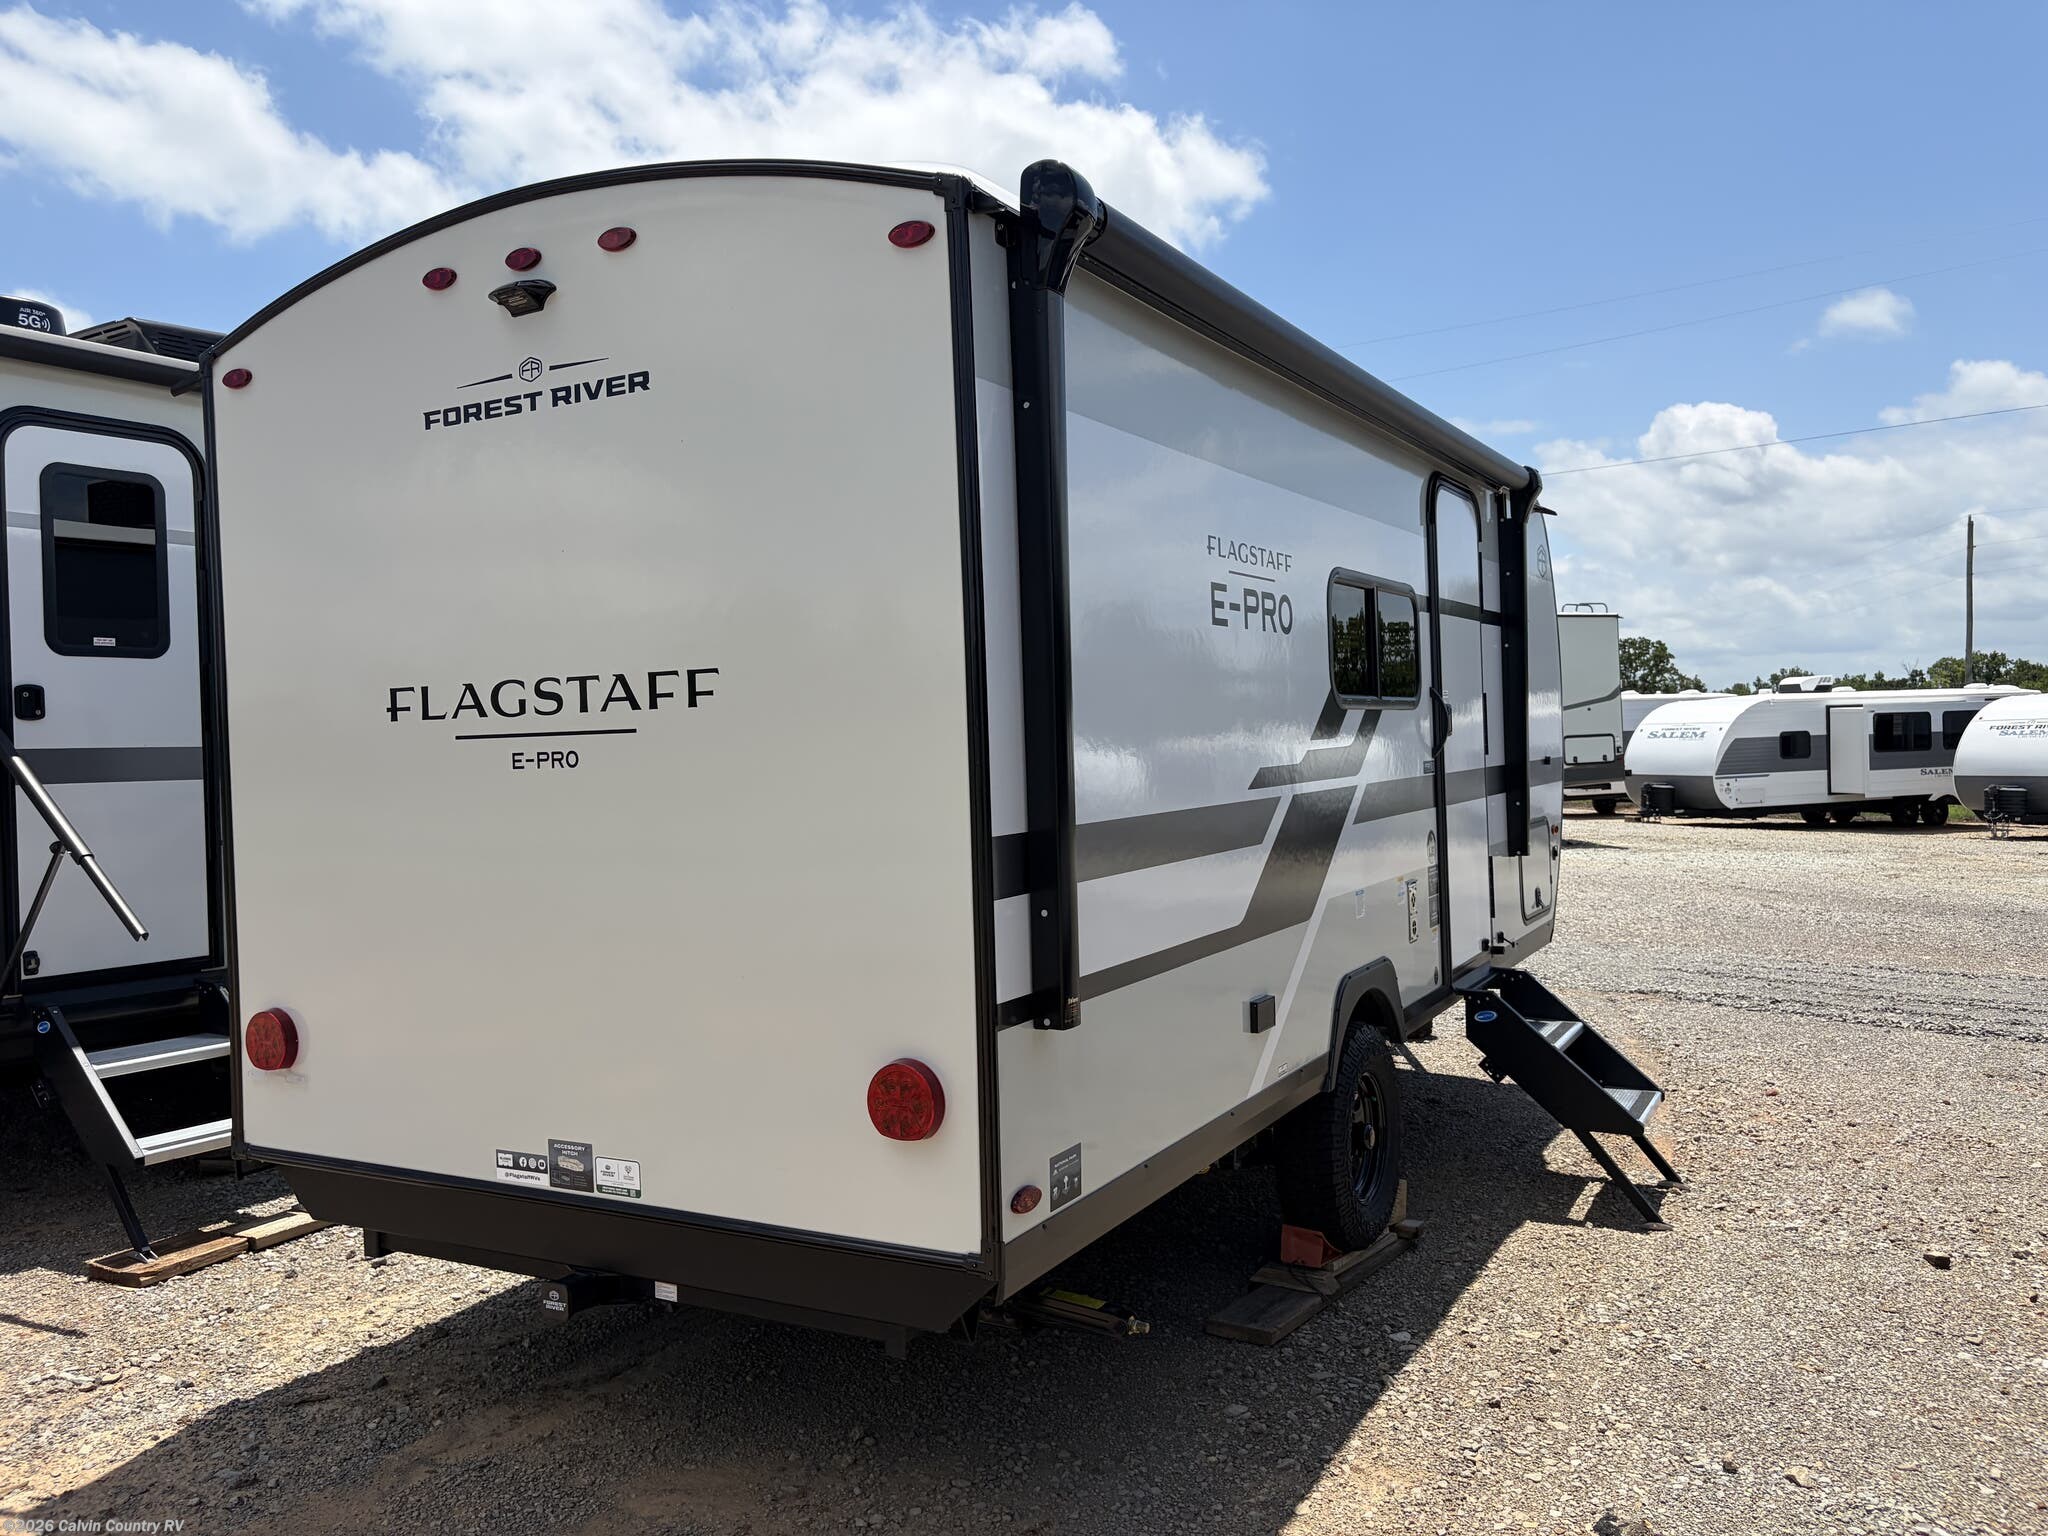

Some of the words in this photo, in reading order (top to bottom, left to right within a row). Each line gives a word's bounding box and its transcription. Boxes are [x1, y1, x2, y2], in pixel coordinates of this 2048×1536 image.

[18, 313, 41, 329] 5G
[423, 391, 543, 430] FOREST
[550, 371, 651, 407] RIVER
[1207, 534, 1292, 572] FLAGSTAFF
[1211, 581, 1293, 635] E-PRO
[386, 667, 720, 722] FLAGSTAFF
[1648, 730, 1707, 739] SALEM
[511, 750, 579, 770] E-PRO
[553, 1143, 585, 1151] ACCESSORY
